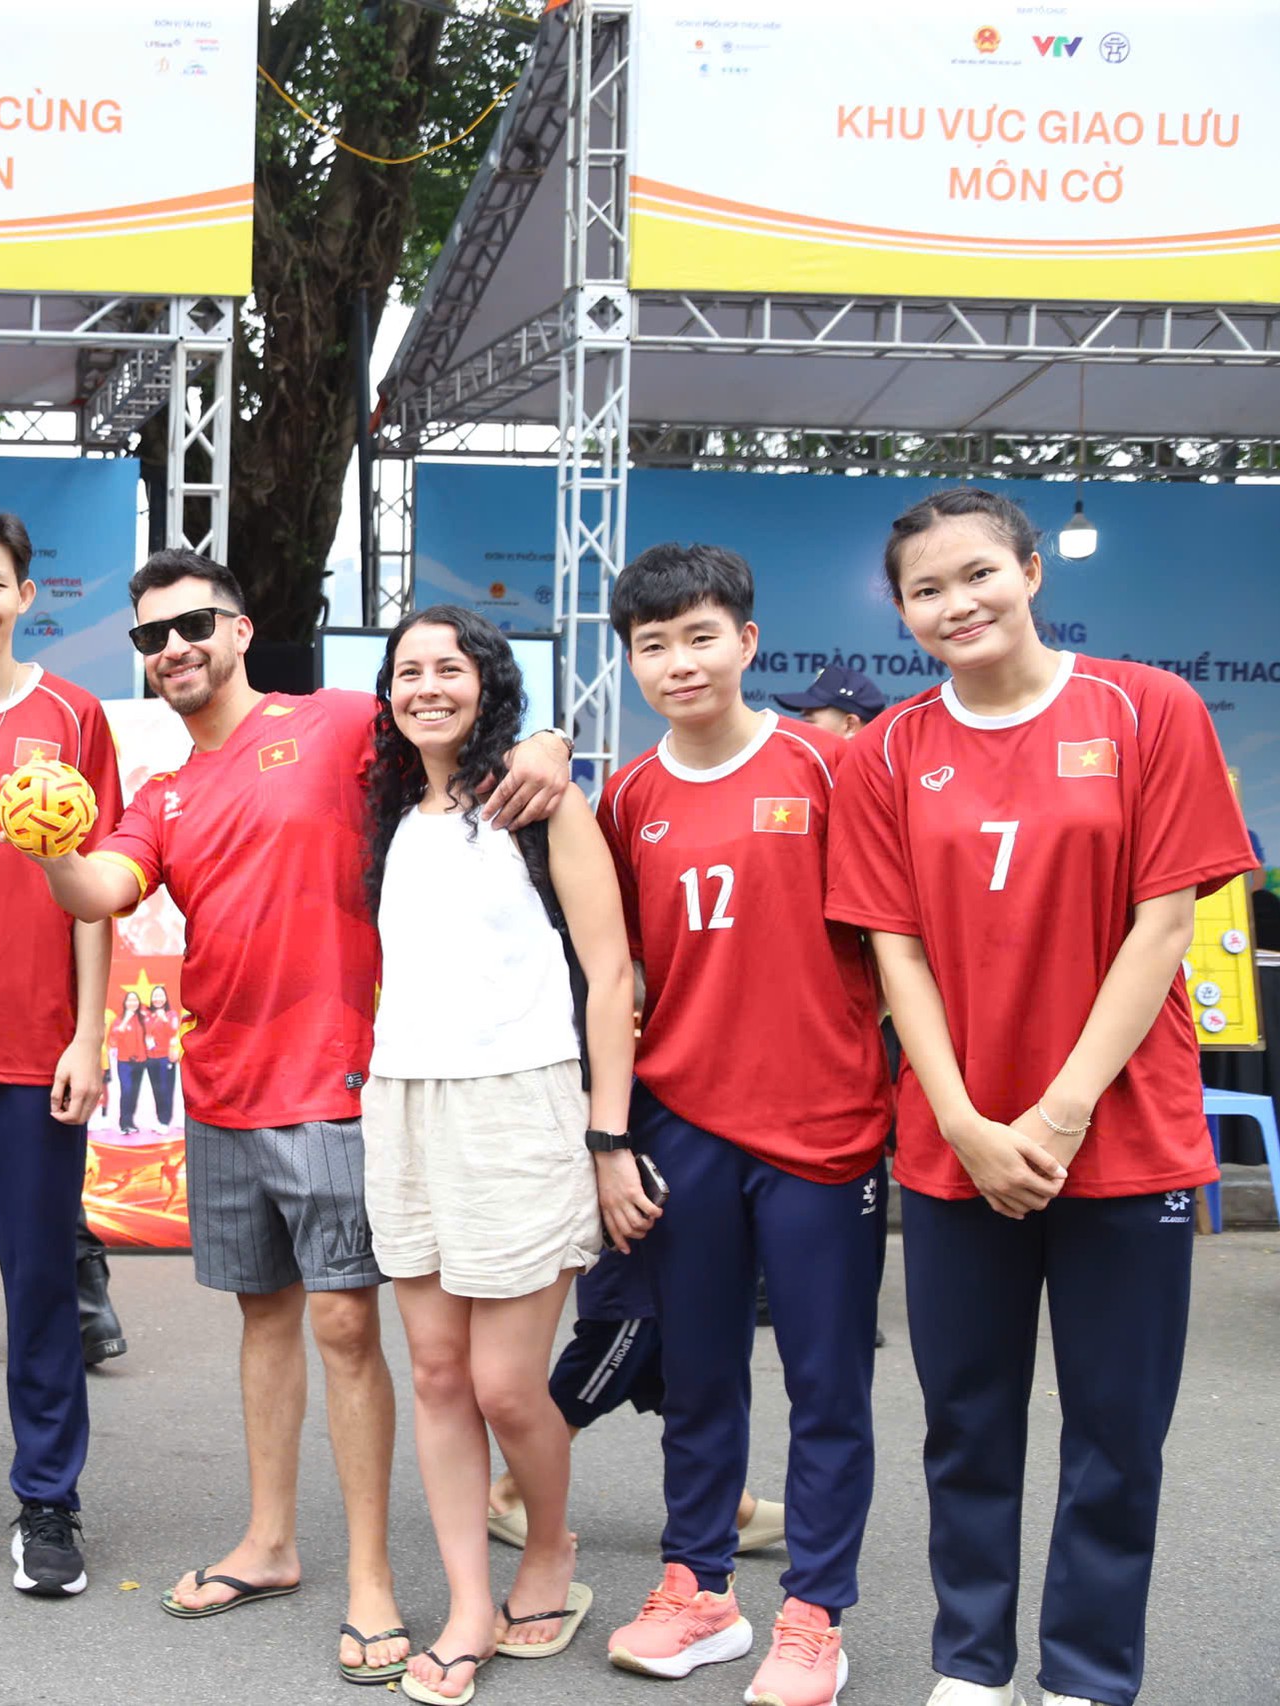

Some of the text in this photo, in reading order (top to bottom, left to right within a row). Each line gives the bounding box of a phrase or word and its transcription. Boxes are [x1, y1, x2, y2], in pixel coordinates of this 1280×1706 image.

[1032, 35, 1083, 58] VTV
[837, 104, 1240, 150] KHU VỰC GIAO LƯU
[949, 159, 1124, 205] MÔN CỜ
[979, 820, 1020, 891] 7
[679, 864, 735, 931] 12
[609, 1337, 634, 1369] SPORT
